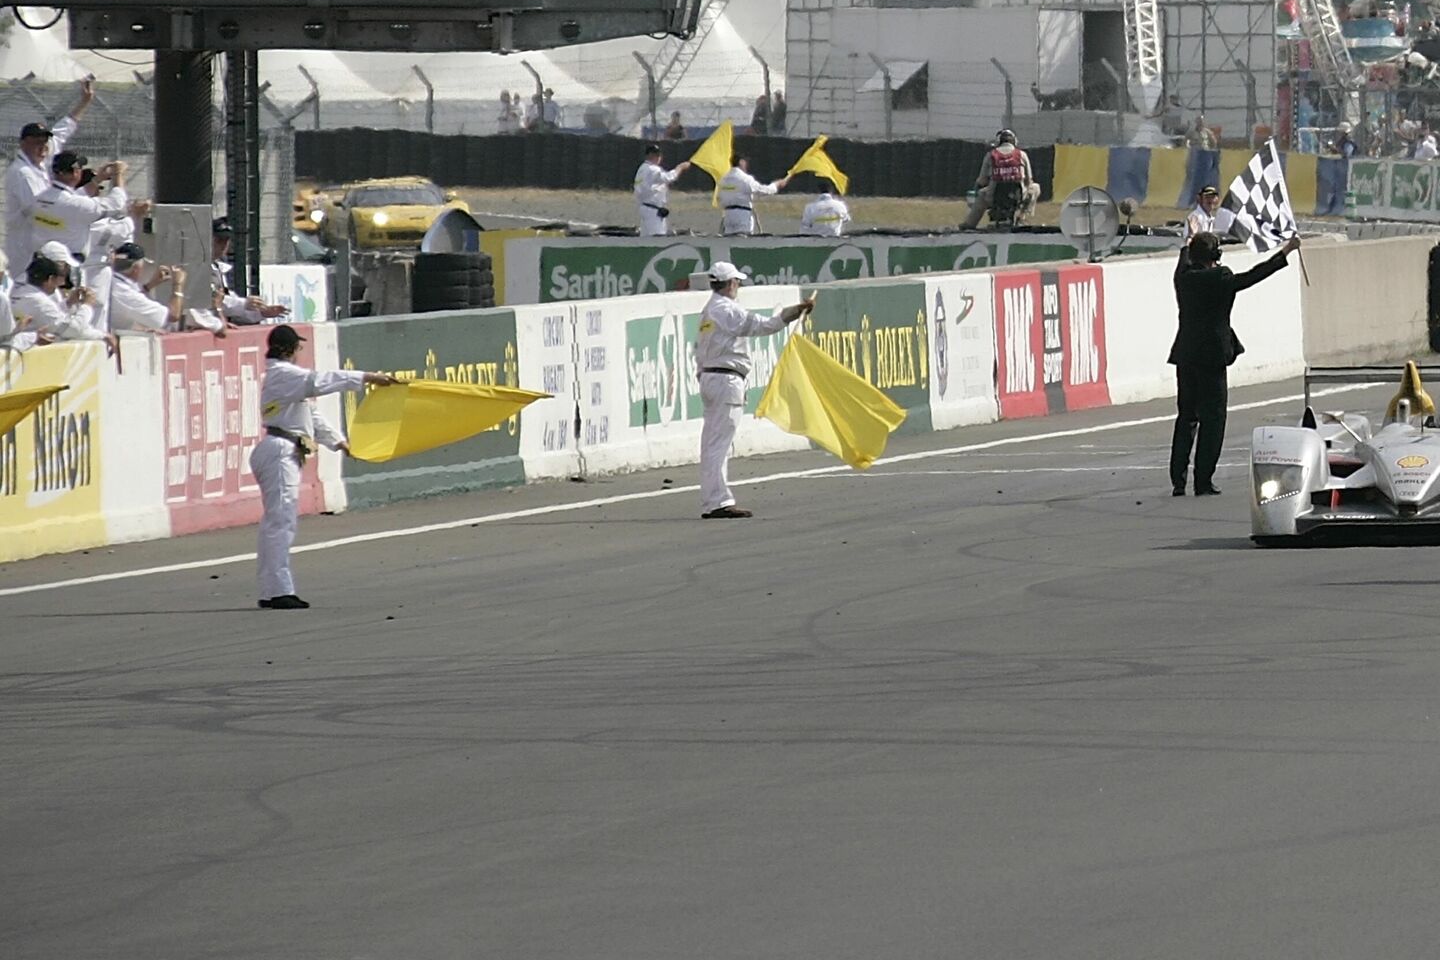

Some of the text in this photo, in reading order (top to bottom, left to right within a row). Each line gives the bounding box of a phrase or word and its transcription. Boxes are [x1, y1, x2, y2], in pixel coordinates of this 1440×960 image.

[549, 265, 633, 299] Sarthe
[1068, 277, 1099, 385] RMC
[875, 326, 915, 389] ROLEX
[1003, 283, 1035, 393] RMC
[34, 390, 91, 493] Nikon
